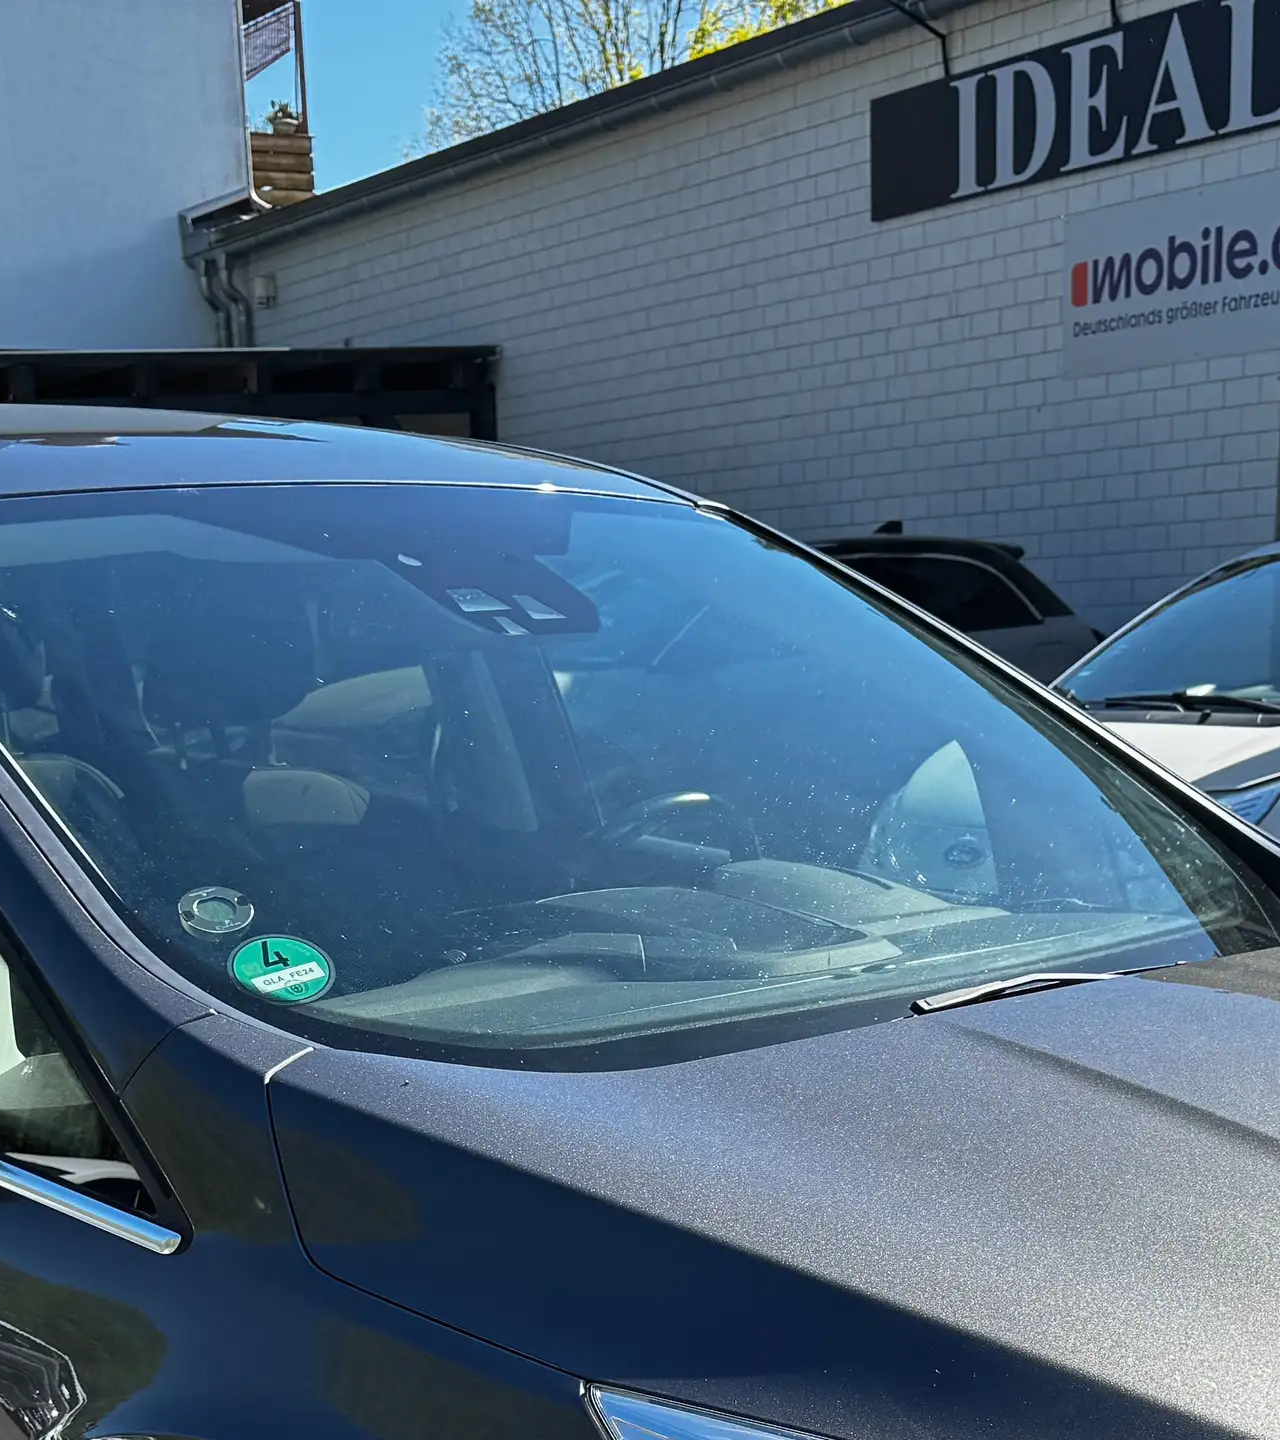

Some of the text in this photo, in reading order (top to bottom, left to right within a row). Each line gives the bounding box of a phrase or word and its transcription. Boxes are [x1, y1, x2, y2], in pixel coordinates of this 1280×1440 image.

[1073, 308, 1162, 337] Deutschlands
[1166, 300, 1218, 325] größter
[261, 941, 290, 967] 4
